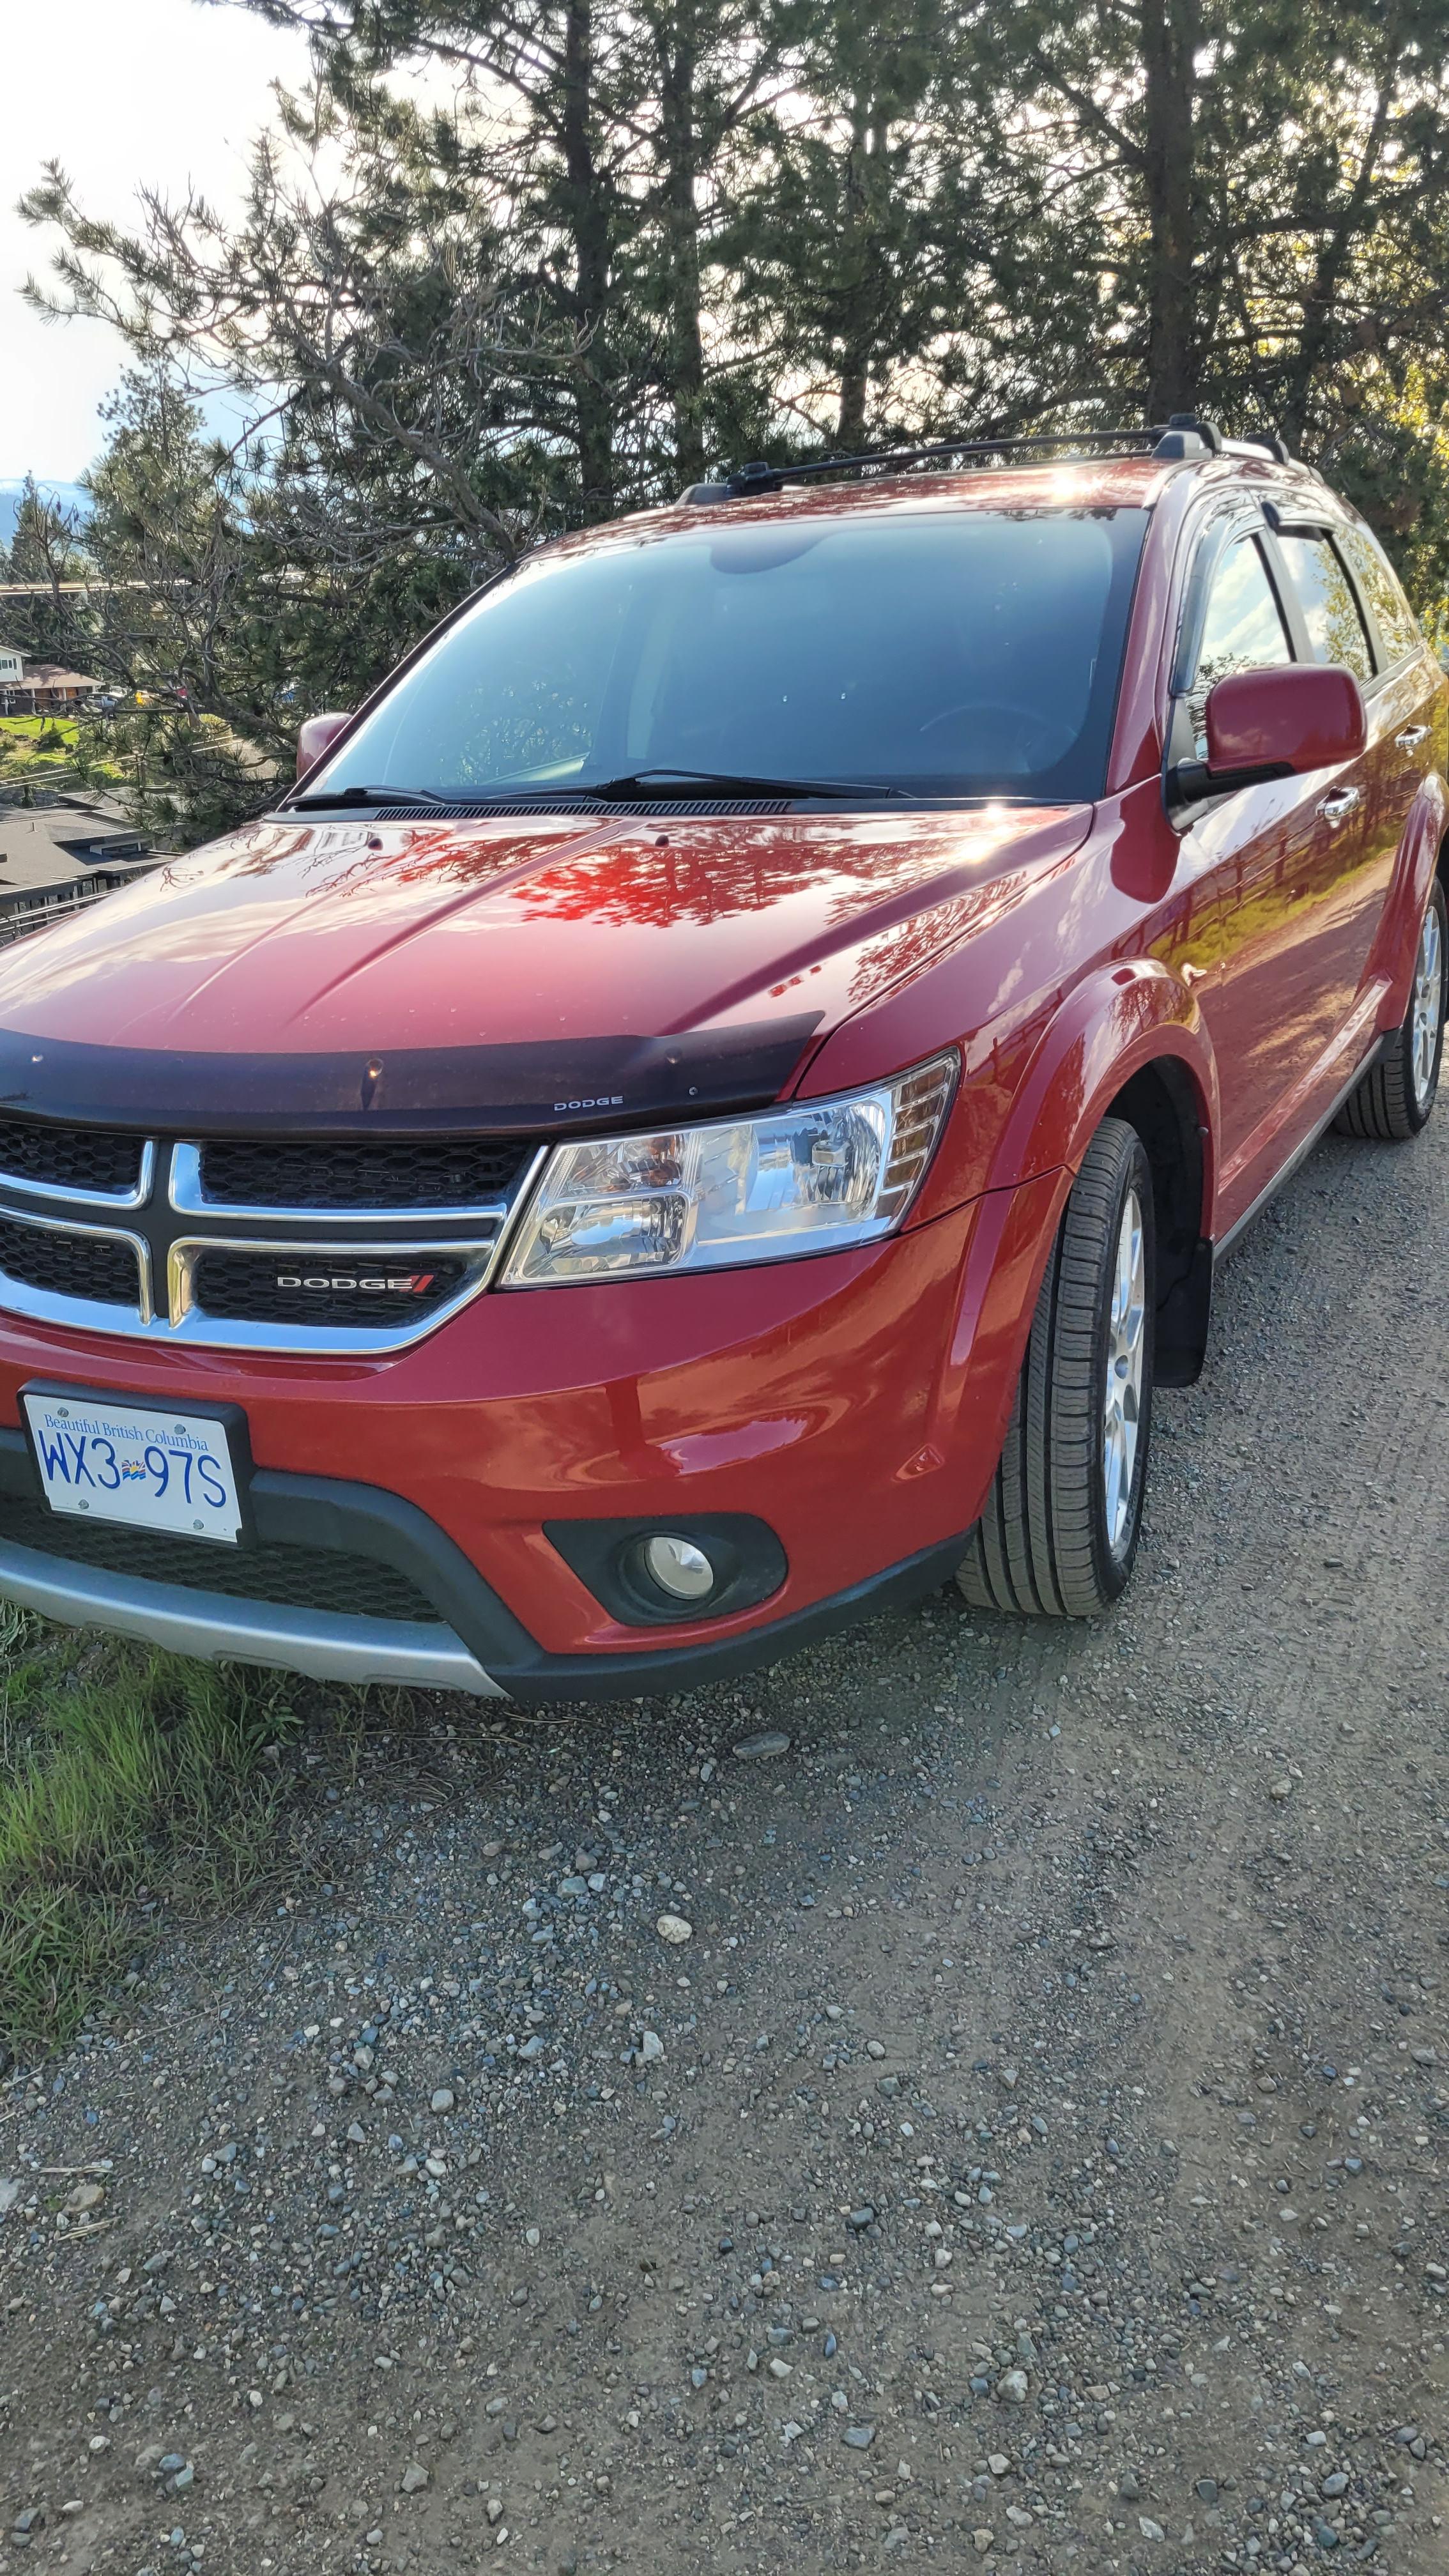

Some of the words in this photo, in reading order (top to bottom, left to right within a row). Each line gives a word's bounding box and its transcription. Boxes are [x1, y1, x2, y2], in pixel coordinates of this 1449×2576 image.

[554, 1096, 623, 1110] DODGE
[277, 1276, 412, 1289] DODGE
[44, 1414, 99, 1435] Beautiful
[102, 1422, 144, 1441] British
[146, 1429, 209, 1452] Columbia
